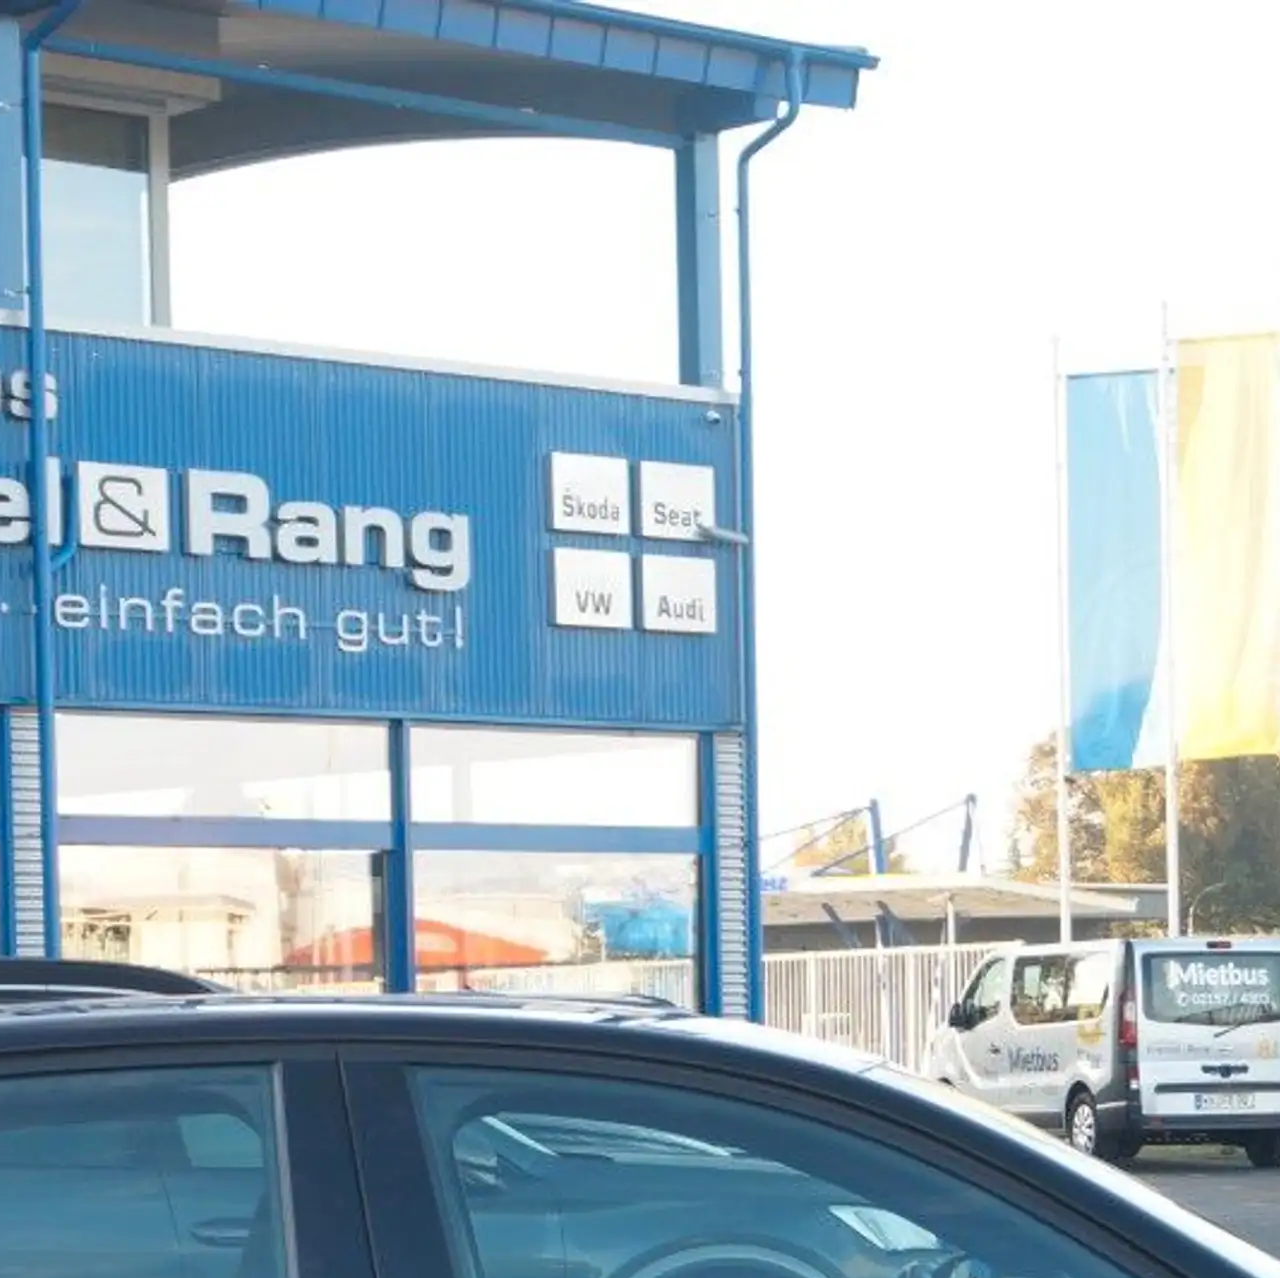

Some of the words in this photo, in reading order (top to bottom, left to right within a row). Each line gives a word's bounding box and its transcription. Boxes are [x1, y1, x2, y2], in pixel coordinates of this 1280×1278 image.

[562, 488, 620, 521] Škoda
[653, 502, 702, 528] Seat
[94, 475, 156, 537] &
[188, 467, 470, 591] Rang
[575, 589, 612, 615] VW
[656, 595, 706, 622] Audi
[337, 605, 464, 652] gut!
[1170, 961, 1269, 986] Mietbus
